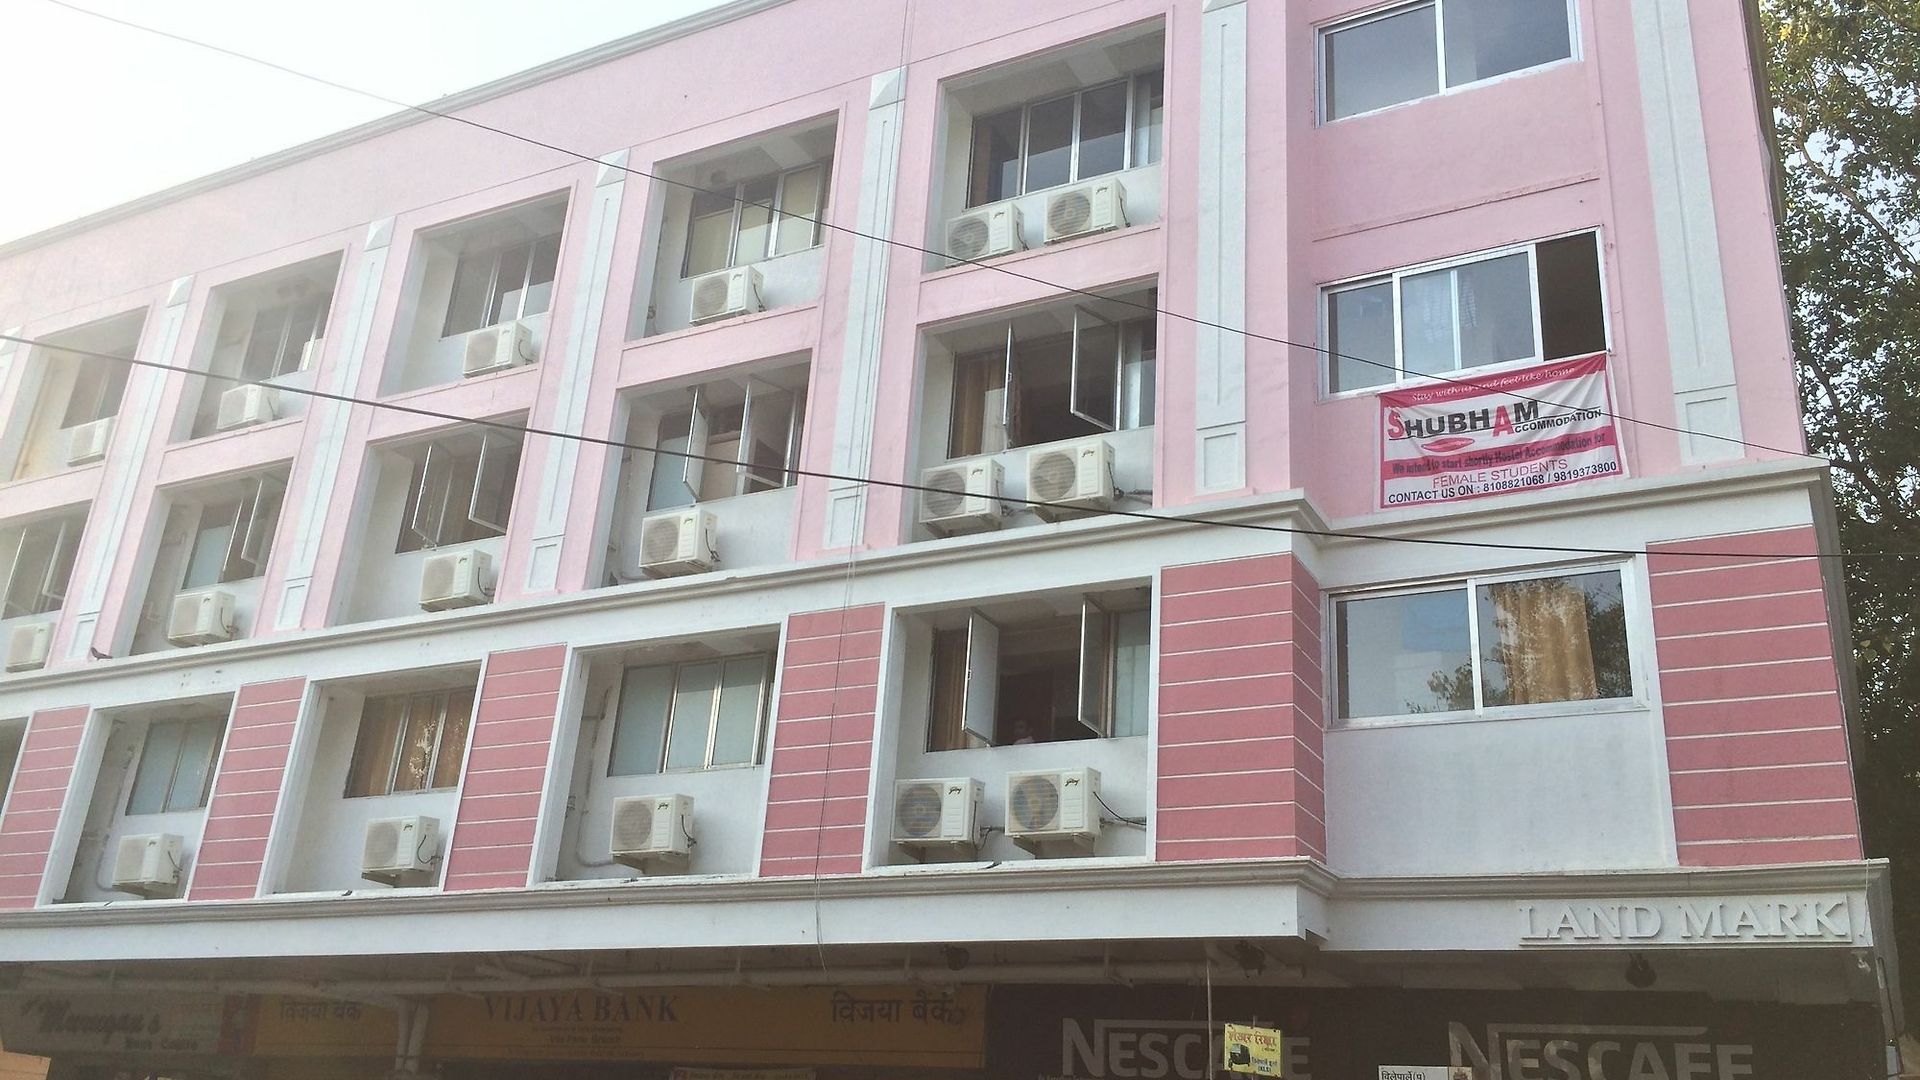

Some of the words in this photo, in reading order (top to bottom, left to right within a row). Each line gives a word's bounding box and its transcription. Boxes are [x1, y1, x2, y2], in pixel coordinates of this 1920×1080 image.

[1545, 367, 1575, 379] home
[1387, 400, 1539, 438] SHUBHAM
[1392, 463, 1405, 474] We
[1441, 459, 1462, 470] start
[1465, 453, 1494, 468] shortly
[1495, 449, 1523, 462] Hostel
[1594, 432, 1606, 444] for
[1388, 490, 1438, 504] CONTACT
[1441, 487, 1455, 499] US
[1458, 485, 1474, 496] ON
[1483, 474, 1545, 492] 8108821068
[1553, 461, 1617, 482] 9819373800
[1432, 472, 1486, 488] FEMALE
[1491, 459, 1568, 480] STUDENTS
[1519, 904, 1662, 941] LAND
[1678, 901, 1848, 939] MARK
[484, 994, 584, 1022] VIJAYA
[593, 994, 680, 1022] BANK
[830, 990, 903, 1023] विजया
[1062, 1017, 1312, 1080] NESCE
